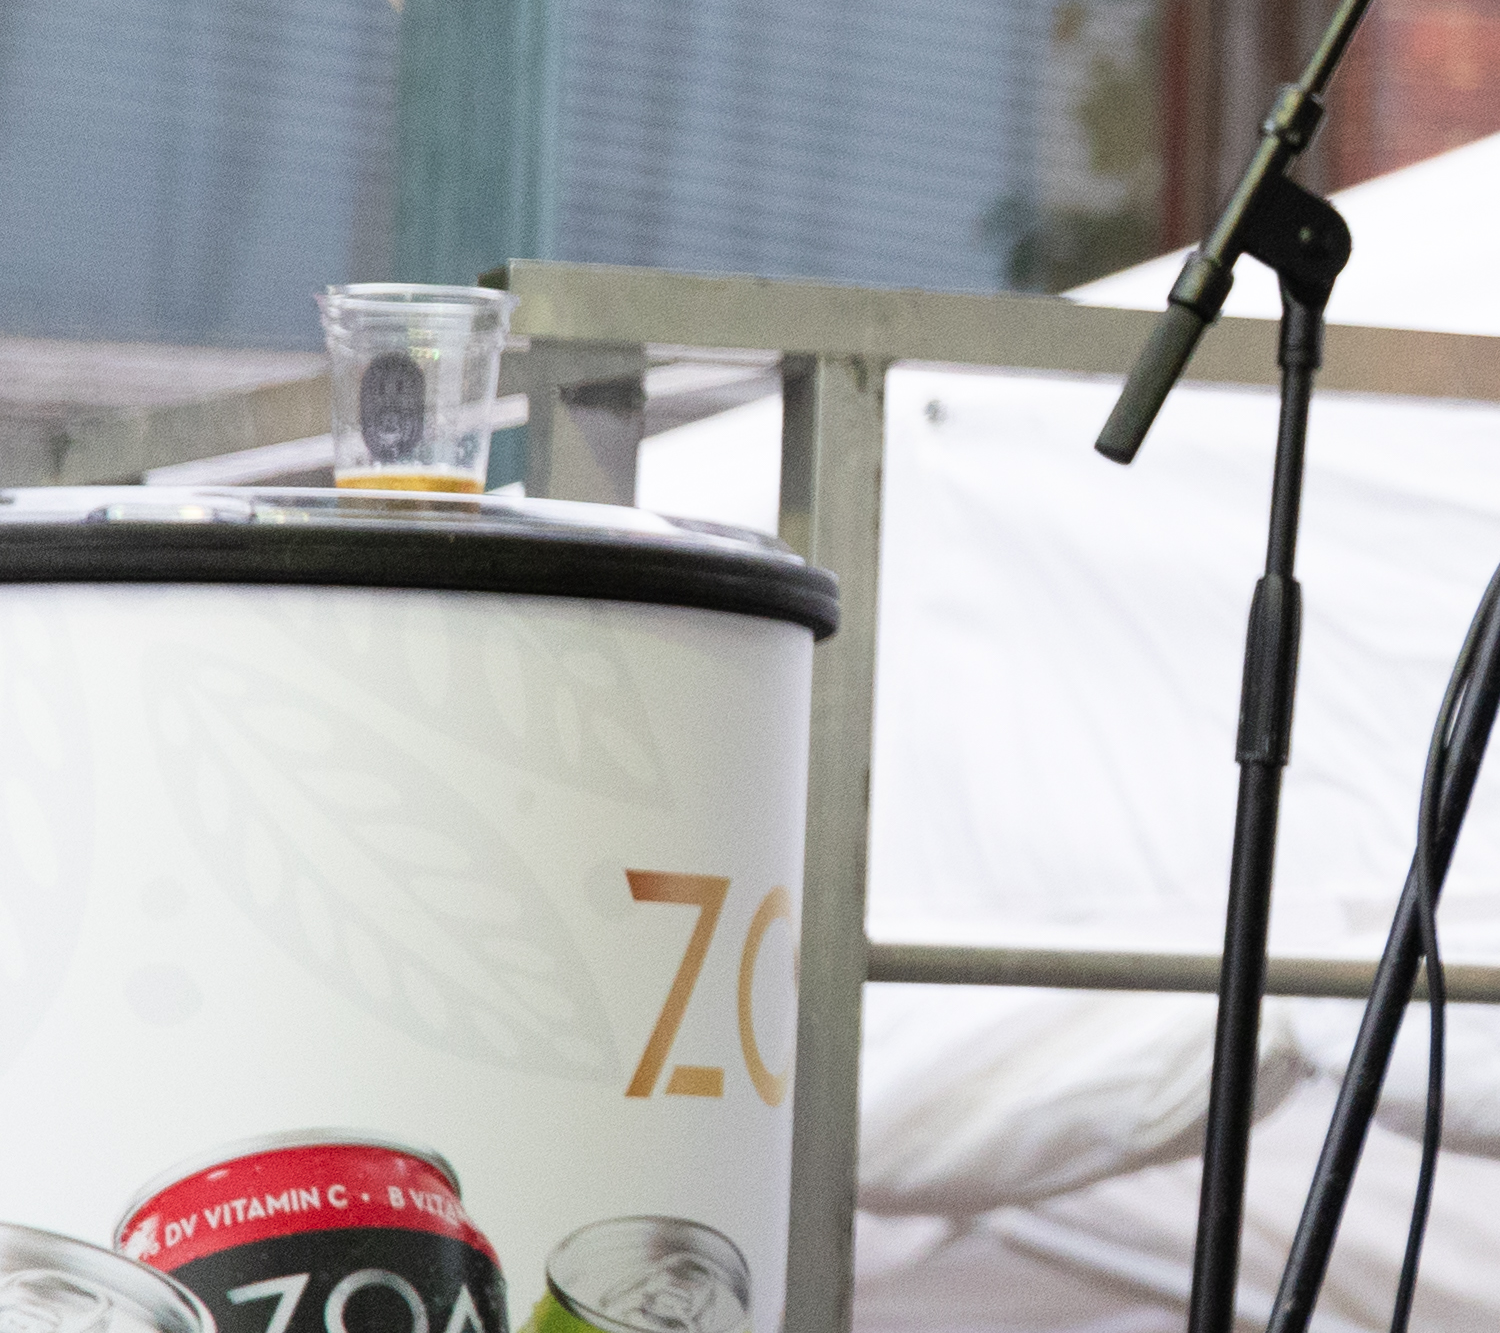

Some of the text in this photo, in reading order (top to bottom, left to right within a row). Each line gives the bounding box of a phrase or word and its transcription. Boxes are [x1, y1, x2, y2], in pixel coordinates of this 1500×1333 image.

[165, 1214, 199, 1249] DV
[204, 1186, 320, 1231] VITAMIN
[327, 1184, 349, 1210] C
[388, 1186, 406, 1210] B
